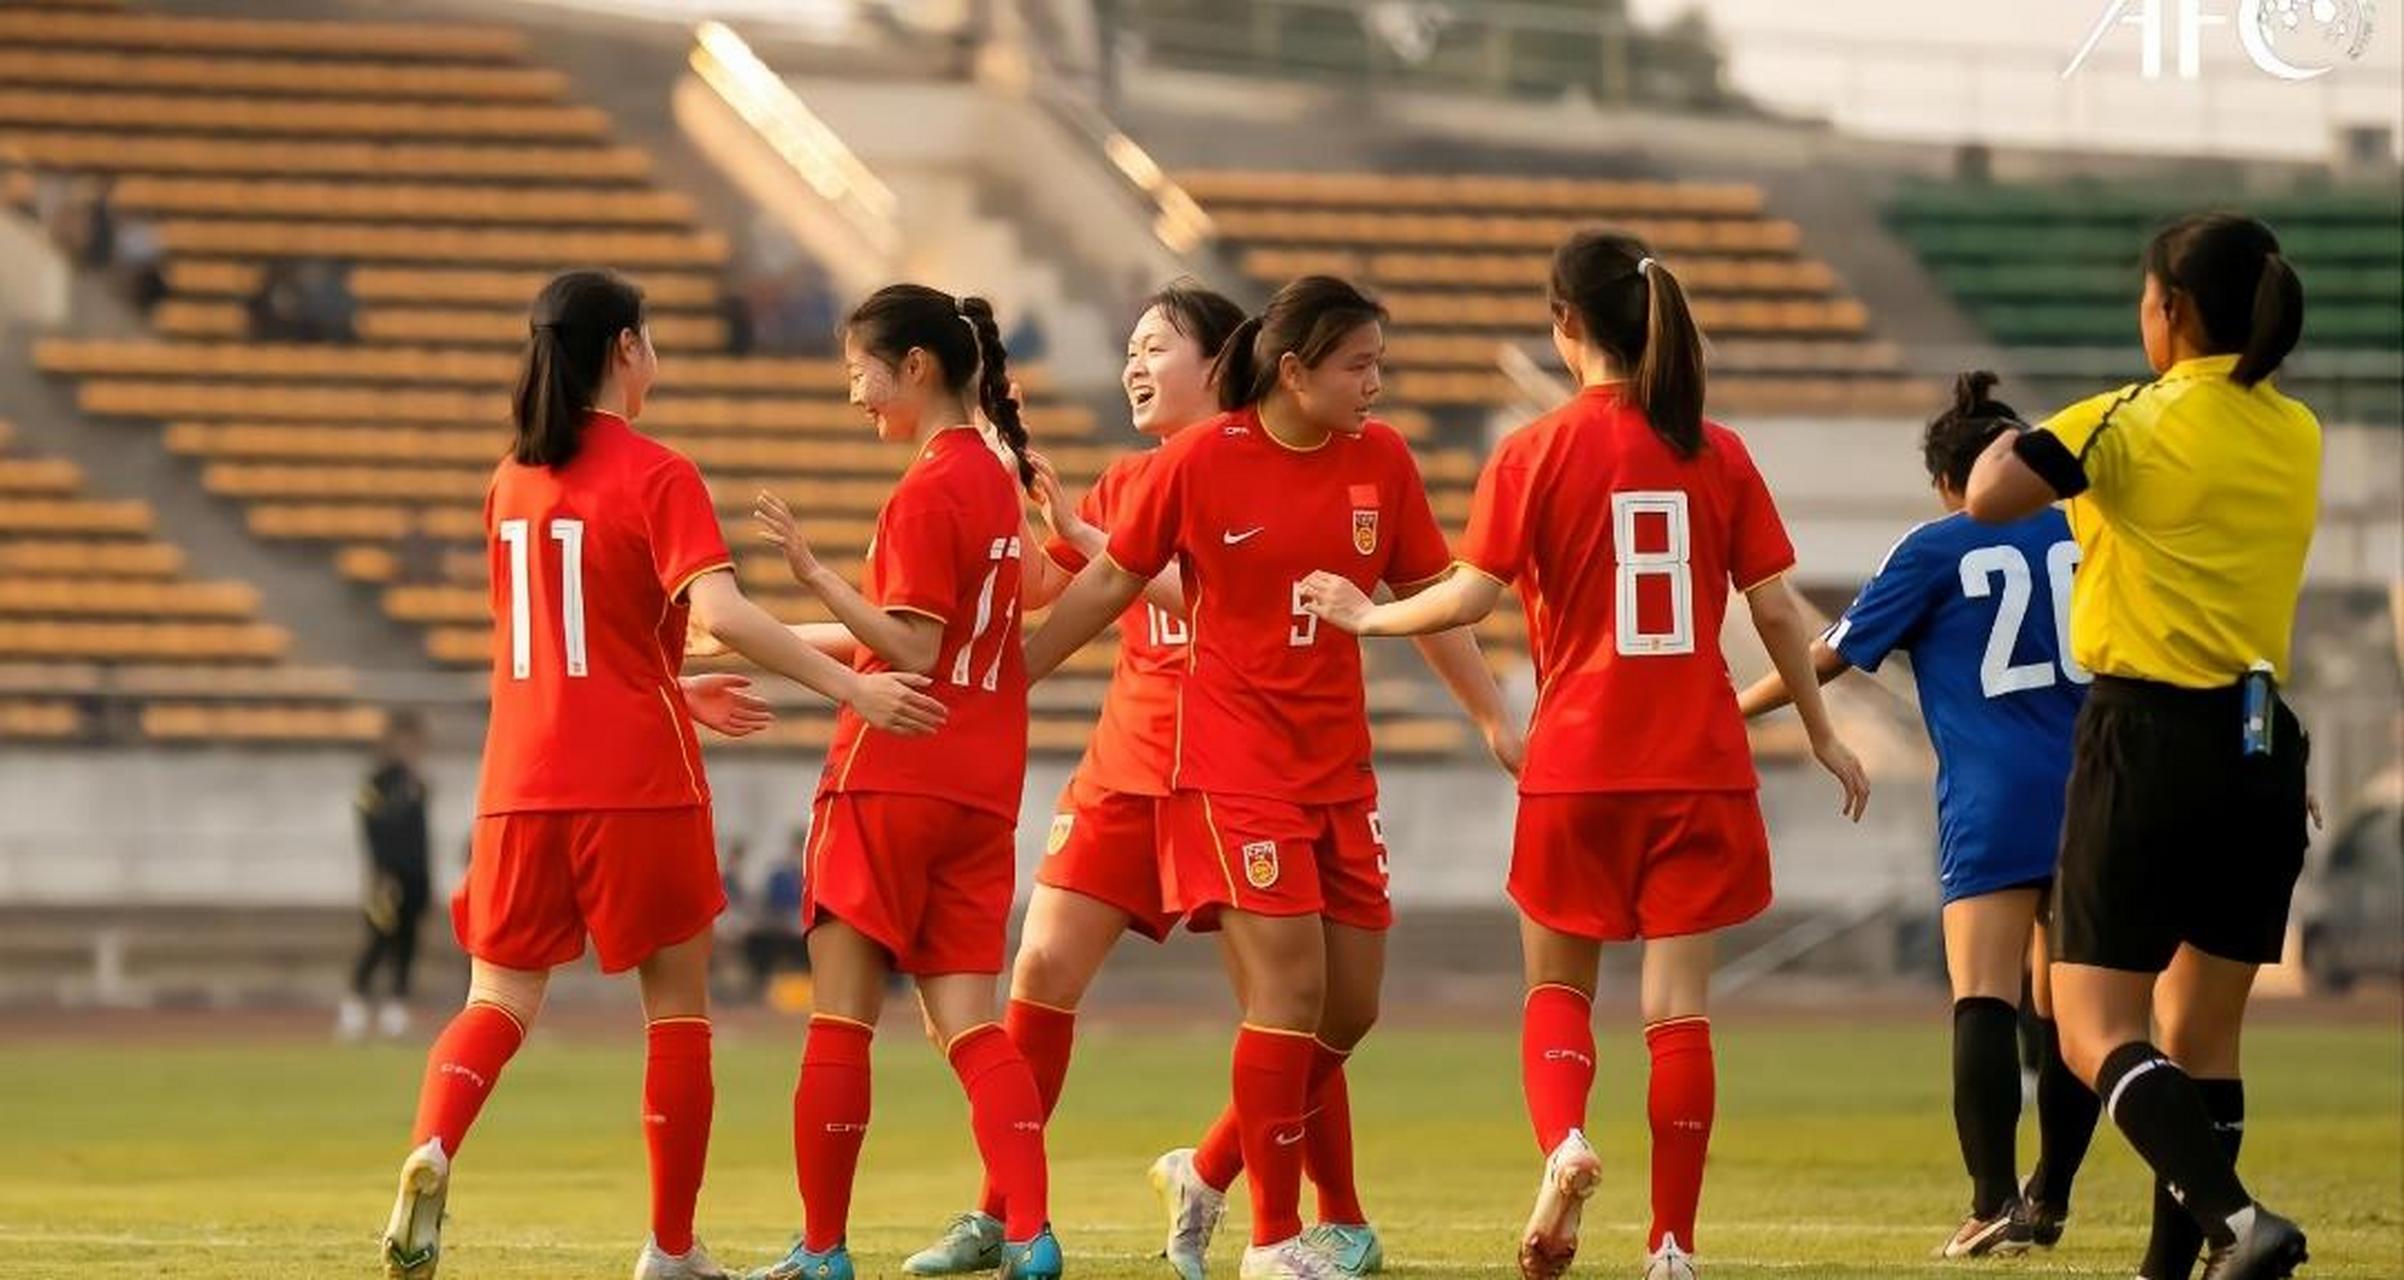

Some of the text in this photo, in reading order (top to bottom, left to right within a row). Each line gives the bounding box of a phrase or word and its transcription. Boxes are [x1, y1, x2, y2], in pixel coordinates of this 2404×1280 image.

[500, 519, 588, 679] 11
[1290, 581, 1318, 646] 5
[1611, 490, 1694, 656] 8
